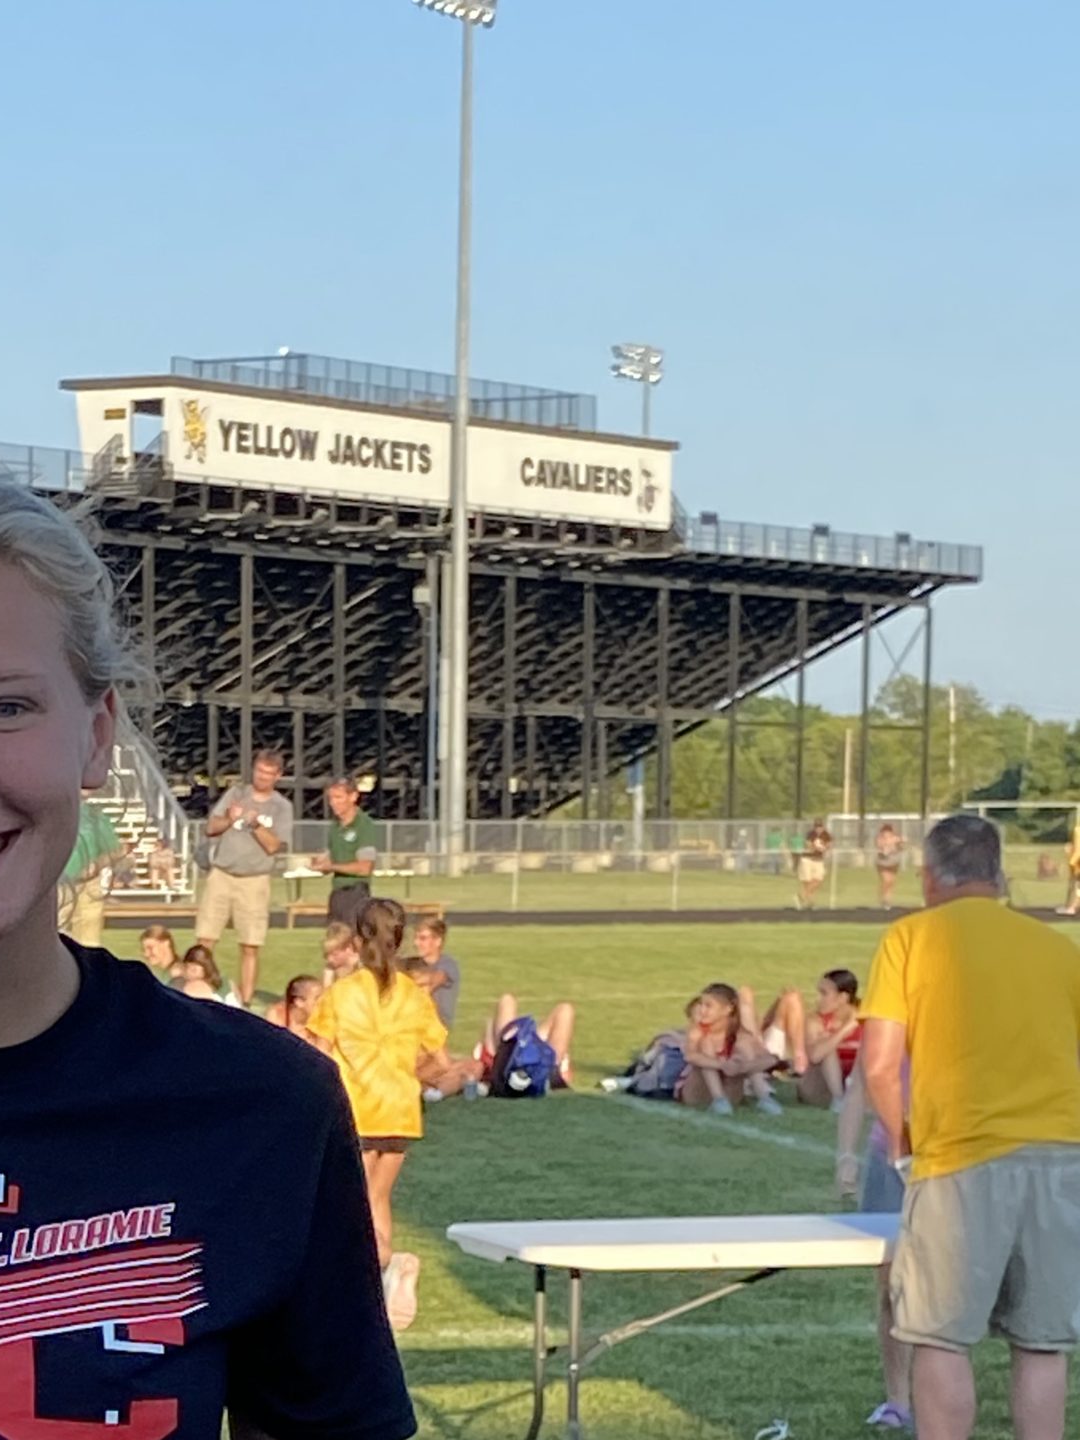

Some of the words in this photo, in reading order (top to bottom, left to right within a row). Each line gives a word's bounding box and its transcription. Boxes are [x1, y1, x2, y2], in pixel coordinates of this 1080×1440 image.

[219, 418, 319, 461] YELLOW
[328, 433, 432, 474] JACKETS
[520, 457, 632, 496] CAVALIERS
